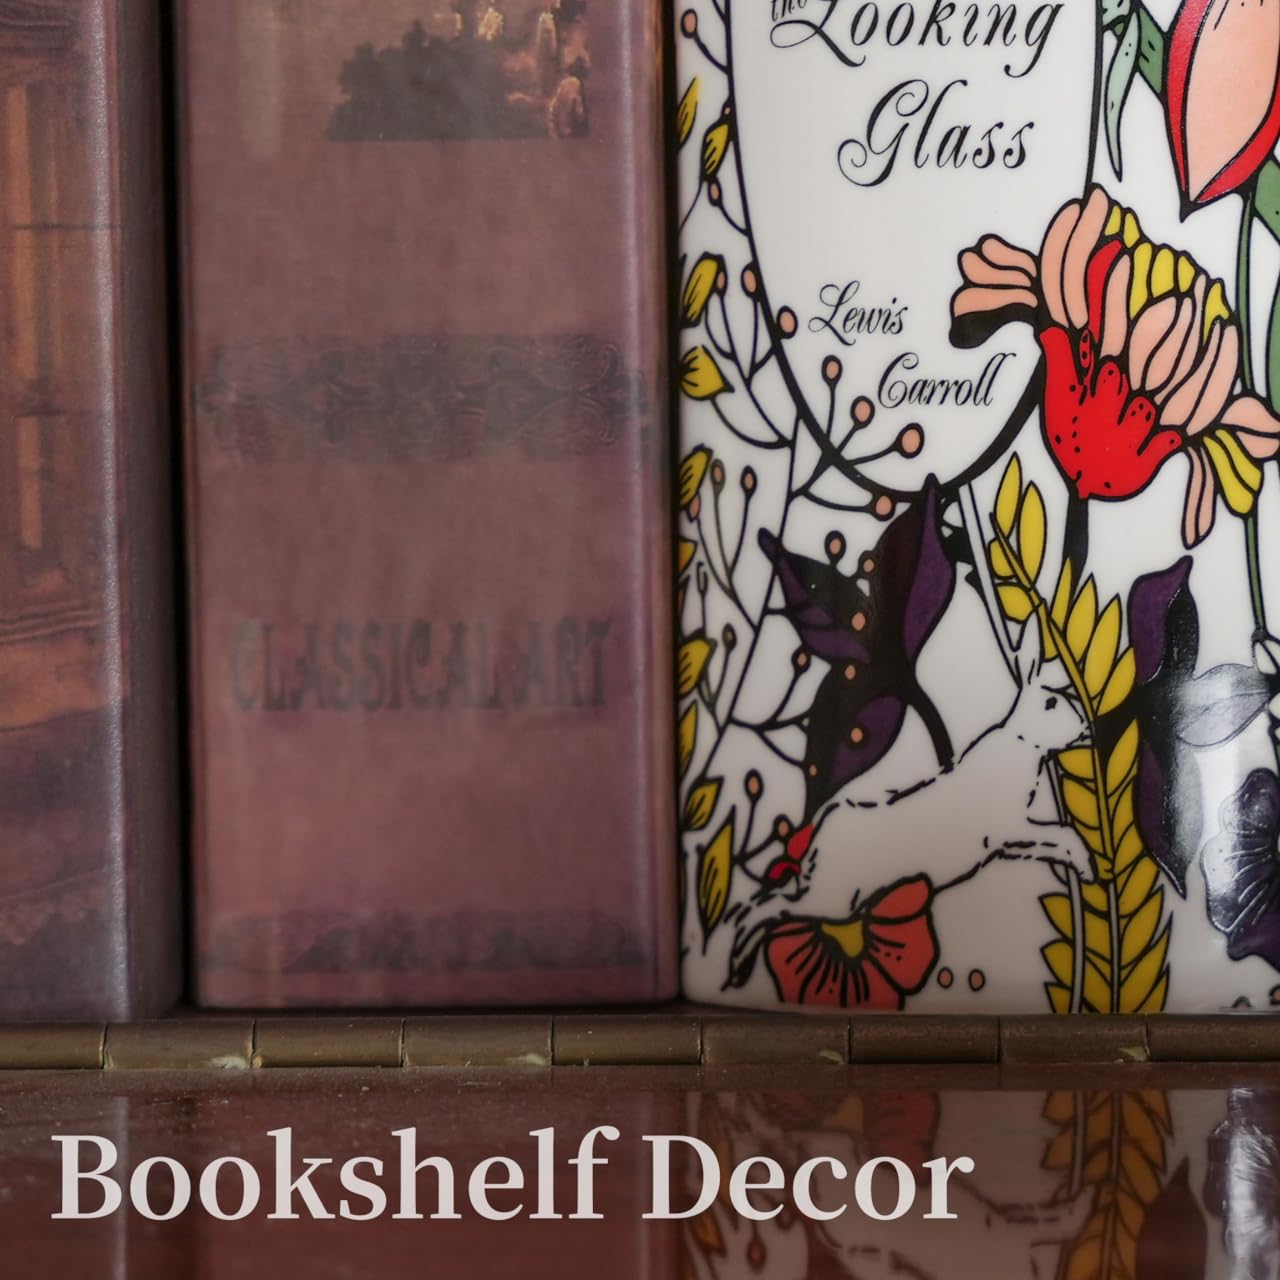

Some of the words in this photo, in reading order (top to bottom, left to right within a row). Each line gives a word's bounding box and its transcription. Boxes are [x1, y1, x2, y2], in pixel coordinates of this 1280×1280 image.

[837, 78, 1035, 187] Glass
[808, 280, 909, 346] Lewis
[877, 352, 1017, 409] Carroll
[232, 618, 503, 713] CLASSICAL
[510, 614, 616, 711] ART
